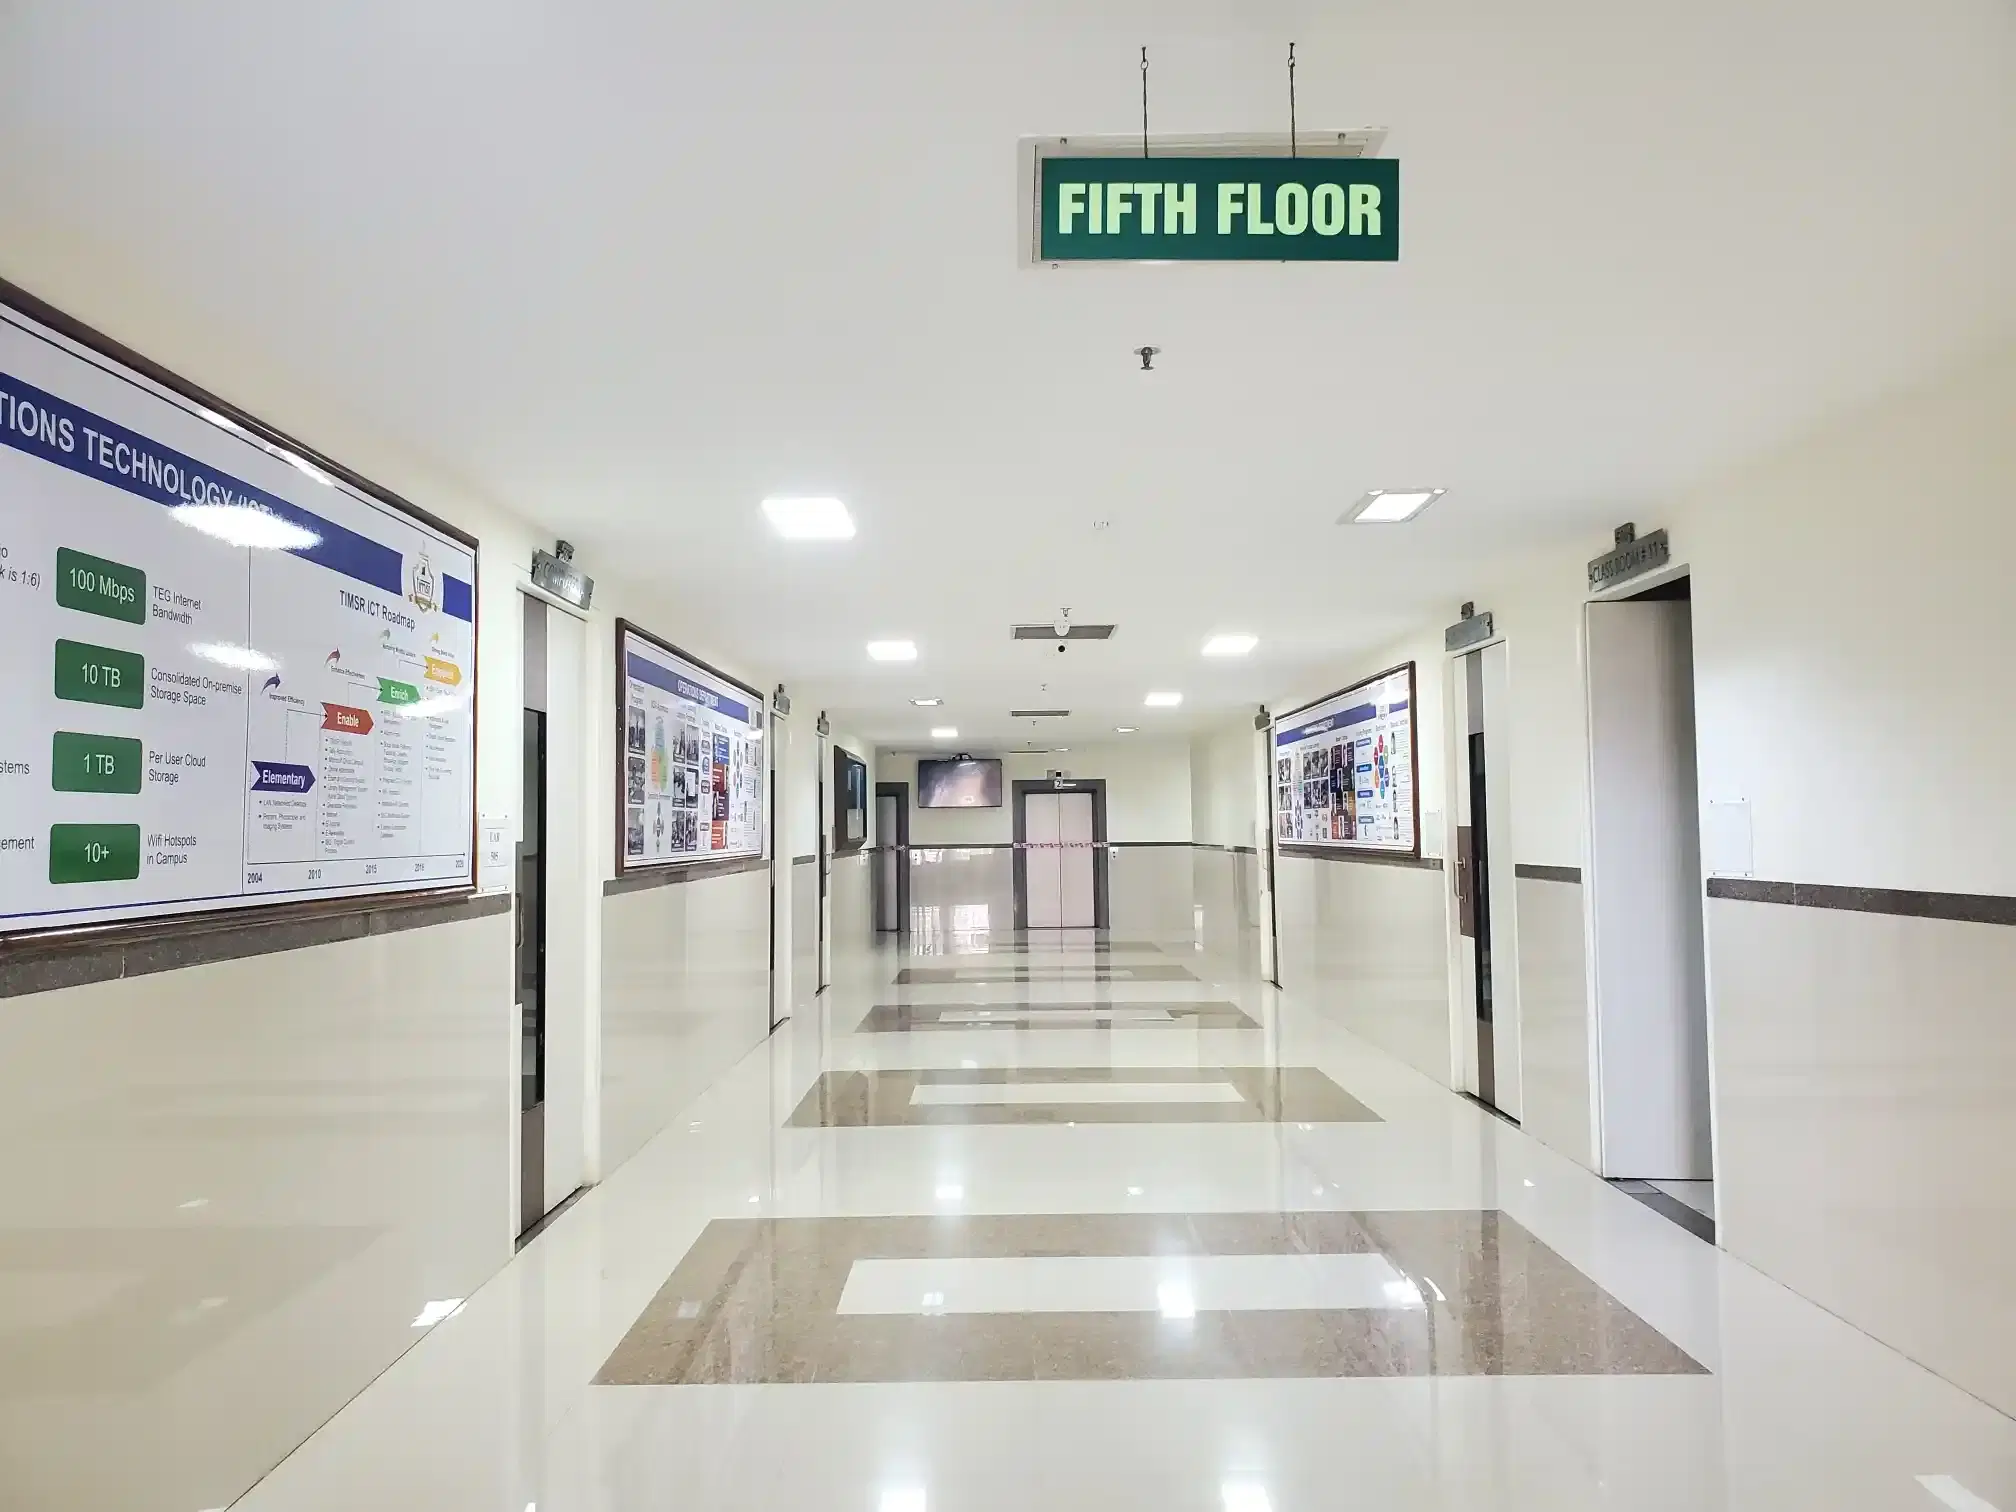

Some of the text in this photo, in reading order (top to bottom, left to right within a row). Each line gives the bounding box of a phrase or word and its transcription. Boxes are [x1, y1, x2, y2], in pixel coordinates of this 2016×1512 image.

[1058, 182, 1382, 236] FIFTH FLOOR
[83, 427, 233, 507] TECHNOLOGY
[8, 567, 17, 583] is
[21, 570, 41, 591] 1:6)
[69, 567, 135, 605] 100 Mbps
[153, 586, 202, 611] TEG Internet
[152, 604, 193, 625] Bandwidth
[340, 590, 416, 633] TIMSR ICT Roadmap
[81, 662, 121, 688] 10 TB
[151, 667, 242, 695] Consolidated On-premise
[150, 685, 207, 706] Storage Space
[337, 711, 360, 728] Enable
[83, 753, 115, 775] 1 TB
[149, 751, 207, 768] Per User Cloud
[148, 768, 180, 786] Storage
[262, 769, 306, 790] Elementary
[147, 834, 197, 848] Wifi Hotspots
[84, 843, 110, 863] 10+
[146, 852, 188, 867] in Campus
[247, 872, 263, 884] 2004
[308, 869, 322, 880] 2010
[365, 864, 377, 874] 2015
